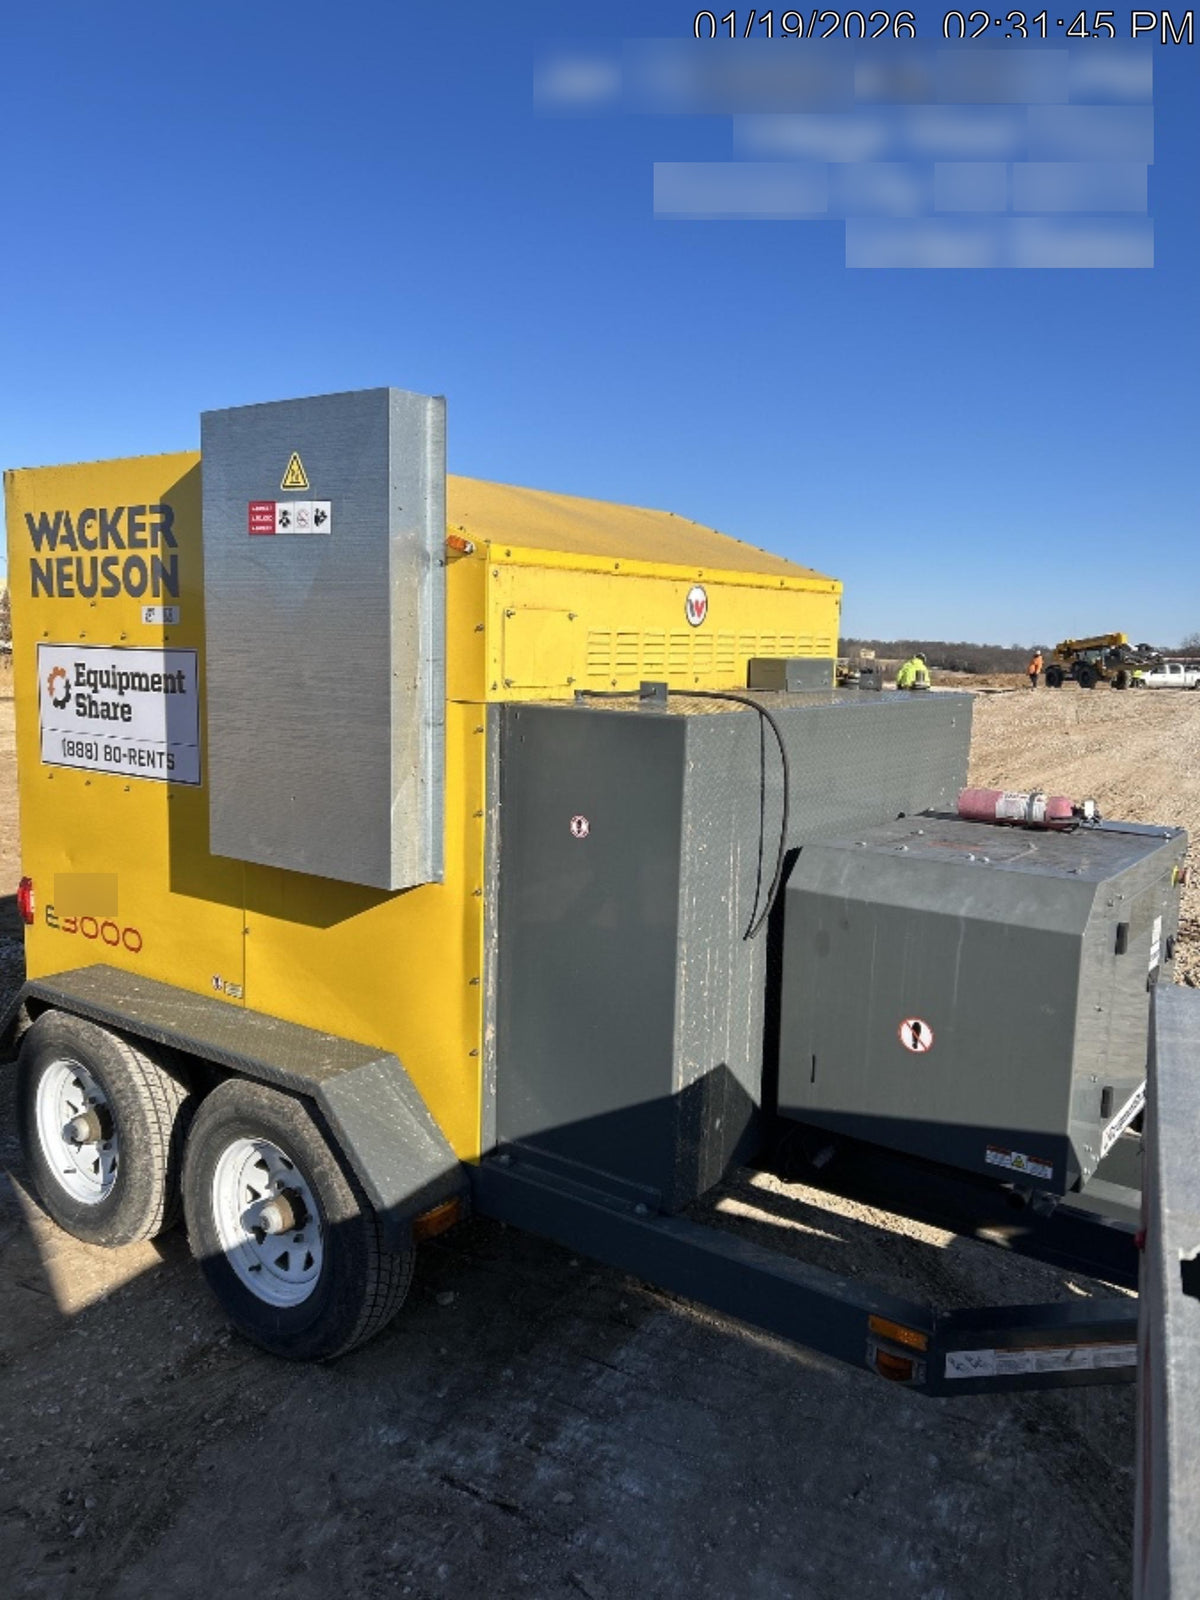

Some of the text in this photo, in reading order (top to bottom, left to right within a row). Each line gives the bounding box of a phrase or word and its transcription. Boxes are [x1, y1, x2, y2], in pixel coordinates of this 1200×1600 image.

[24, 504, 179, 552] WACKER
[29, 554, 180, 598] NEUSON
[74, 662, 187, 696] Equipment
[75, 692, 132, 723] Share
[62, 737, 99, 762] (888)
